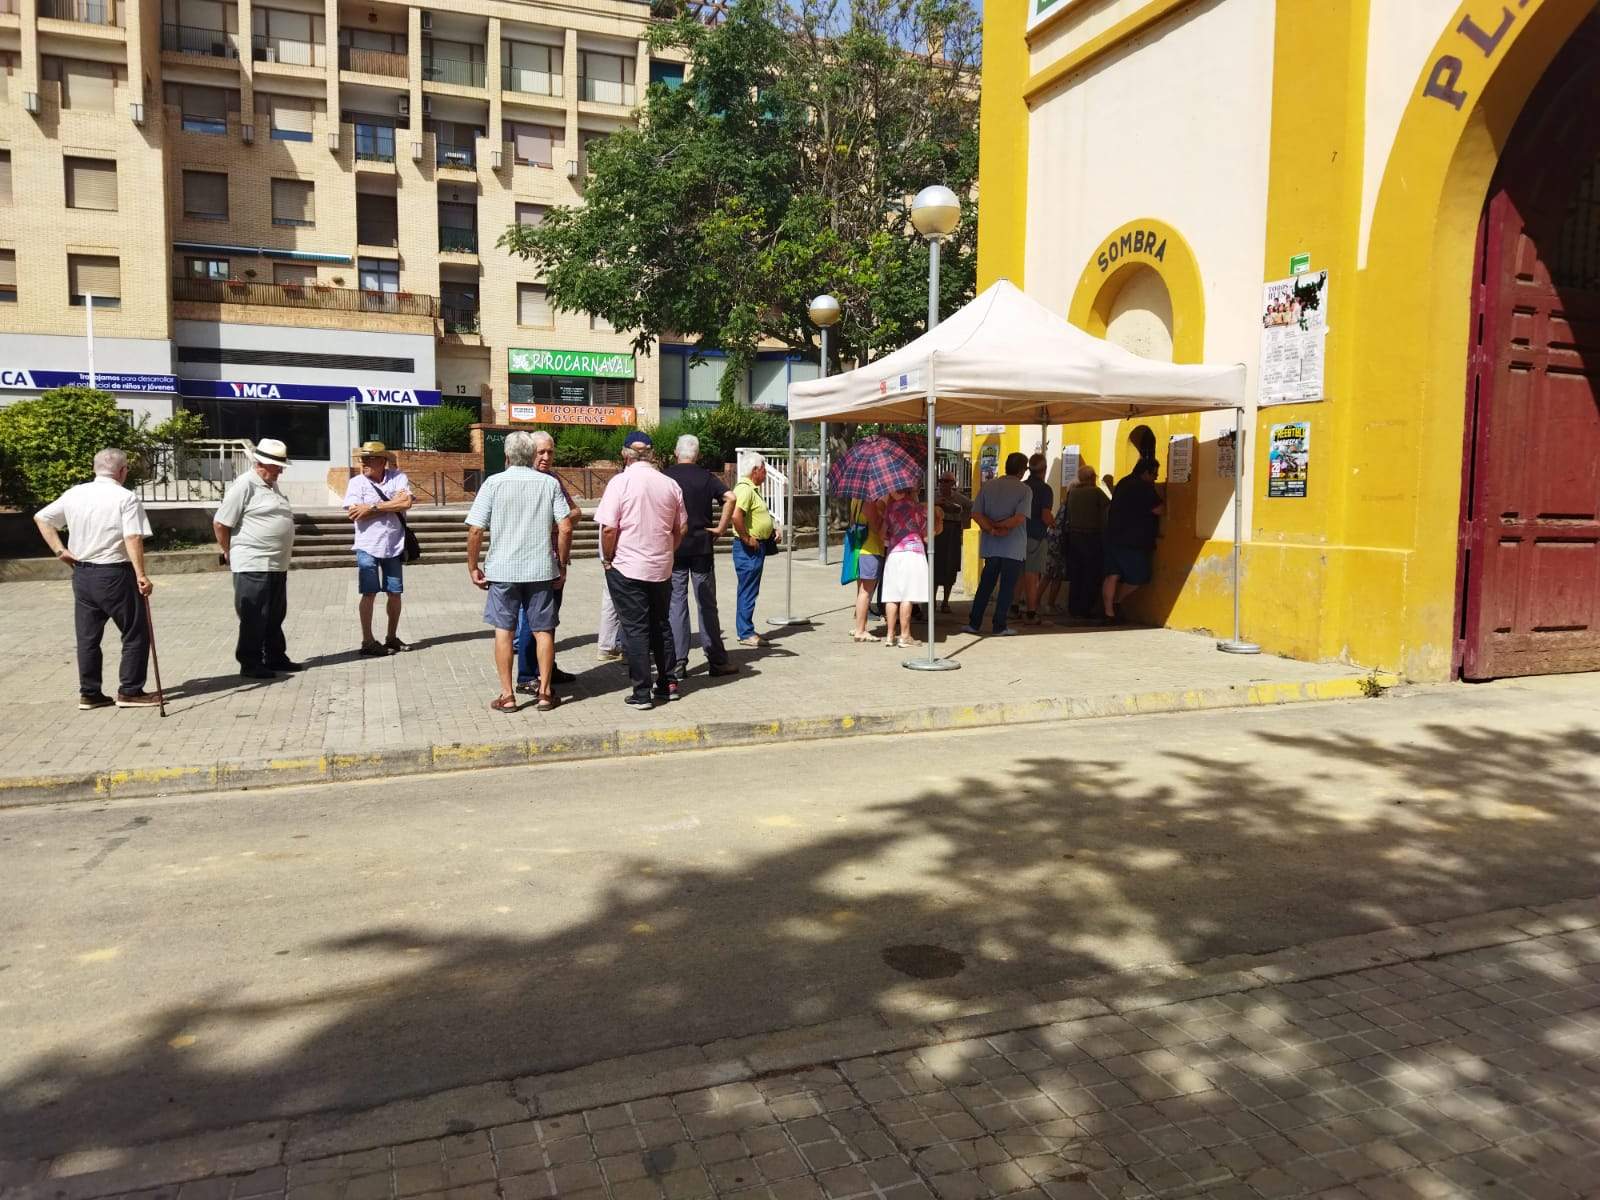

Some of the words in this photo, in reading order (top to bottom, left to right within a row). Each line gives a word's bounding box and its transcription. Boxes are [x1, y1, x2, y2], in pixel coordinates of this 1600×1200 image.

[1423, 0, 1529, 111] PL
[1097, 230, 1167, 273] SOMBRA
[79, 373, 120, 382] Traajamos
[137, 375, 174, 384] desarrollar
[122, 382, 141, 390] niños
[147, 383, 175, 391] jóvenes
[230, 383, 281, 398] YMCA
[456, 385, 466, 394] 13
[366, 388, 412, 404] YMCA
[543, 405, 616, 415] PIROTECNIA
[553, 414, 606, 423] OSCENSE
